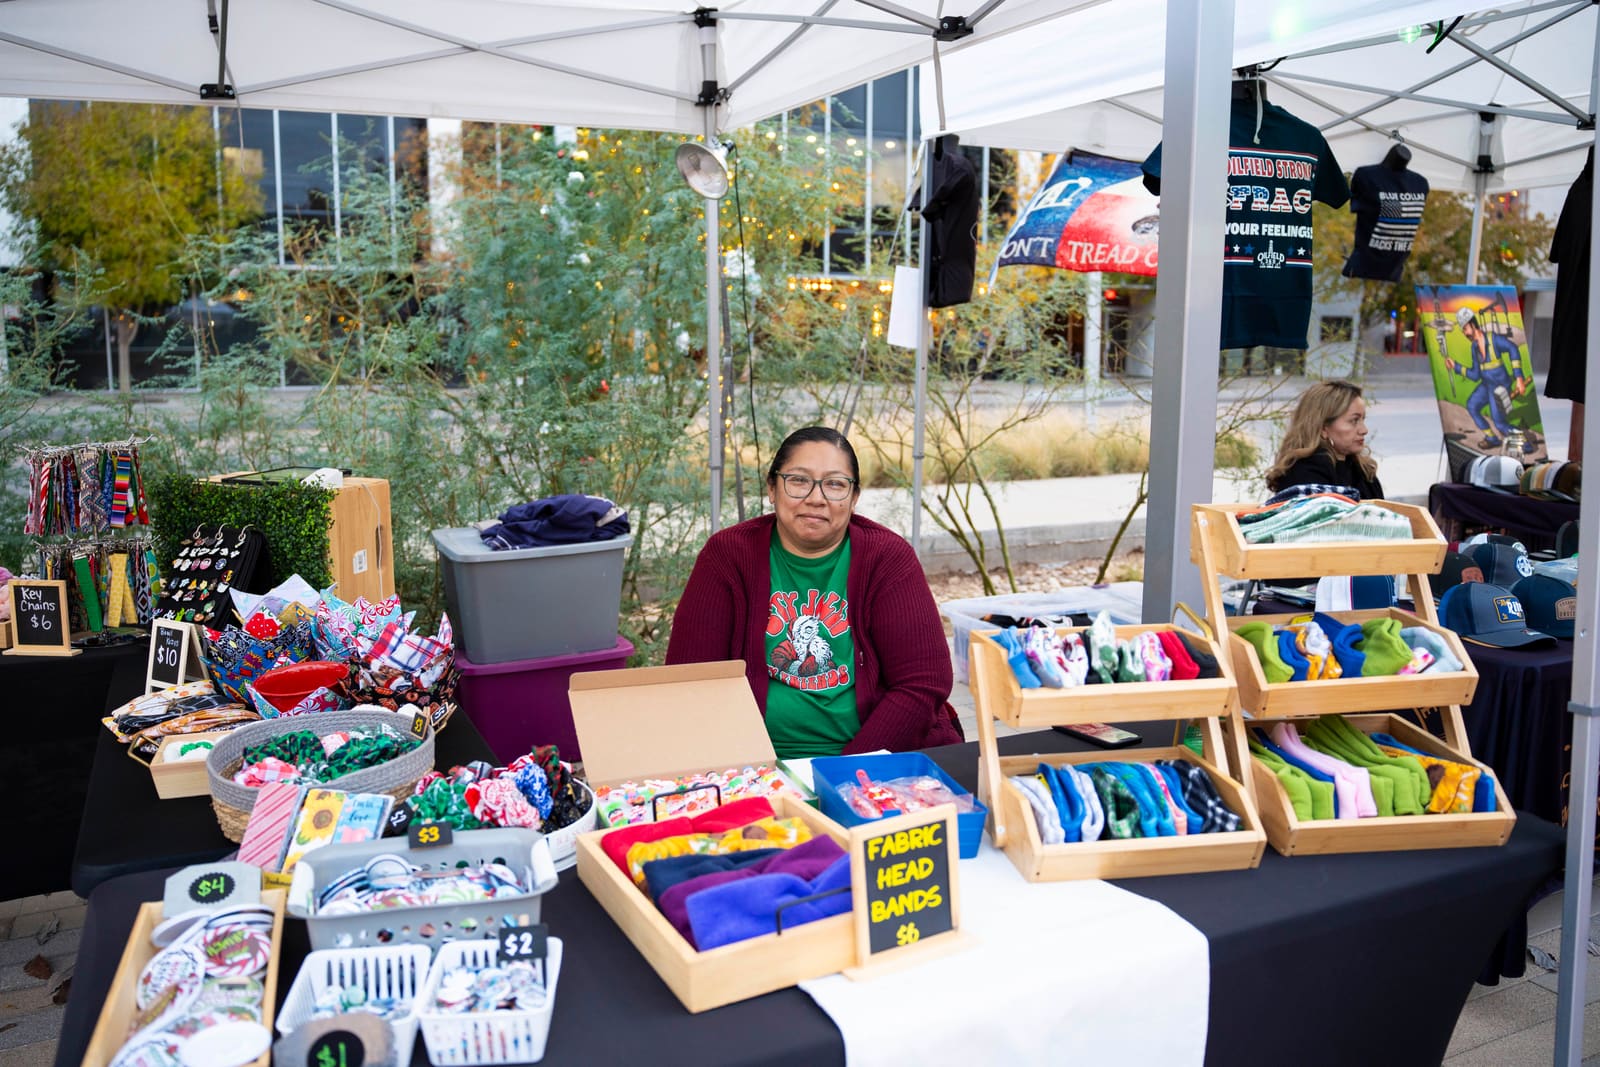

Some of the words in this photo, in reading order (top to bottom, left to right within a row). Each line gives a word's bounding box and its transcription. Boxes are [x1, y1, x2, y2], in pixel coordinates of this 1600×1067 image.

[1224, 222, 1260, 236] YOUR
[999, 236, 1055, 260] ON'T
[1067, 240, 1140, 266] TREAD
[21, 586, 42, 602] Key
[21, 600, 56, 612] Chains
[157, 645, 177, 667] $10
[418, 826, 440, 844] $3
[867, 823, 943, 861] FABRIC
[876, 857, 935, 890] HEAD
[197, 876, 225, 897] $4
[870, 885, 943, 923] BANDS
[504, 931, 533, 957] $2
[896, 922, 920, 946] $6
